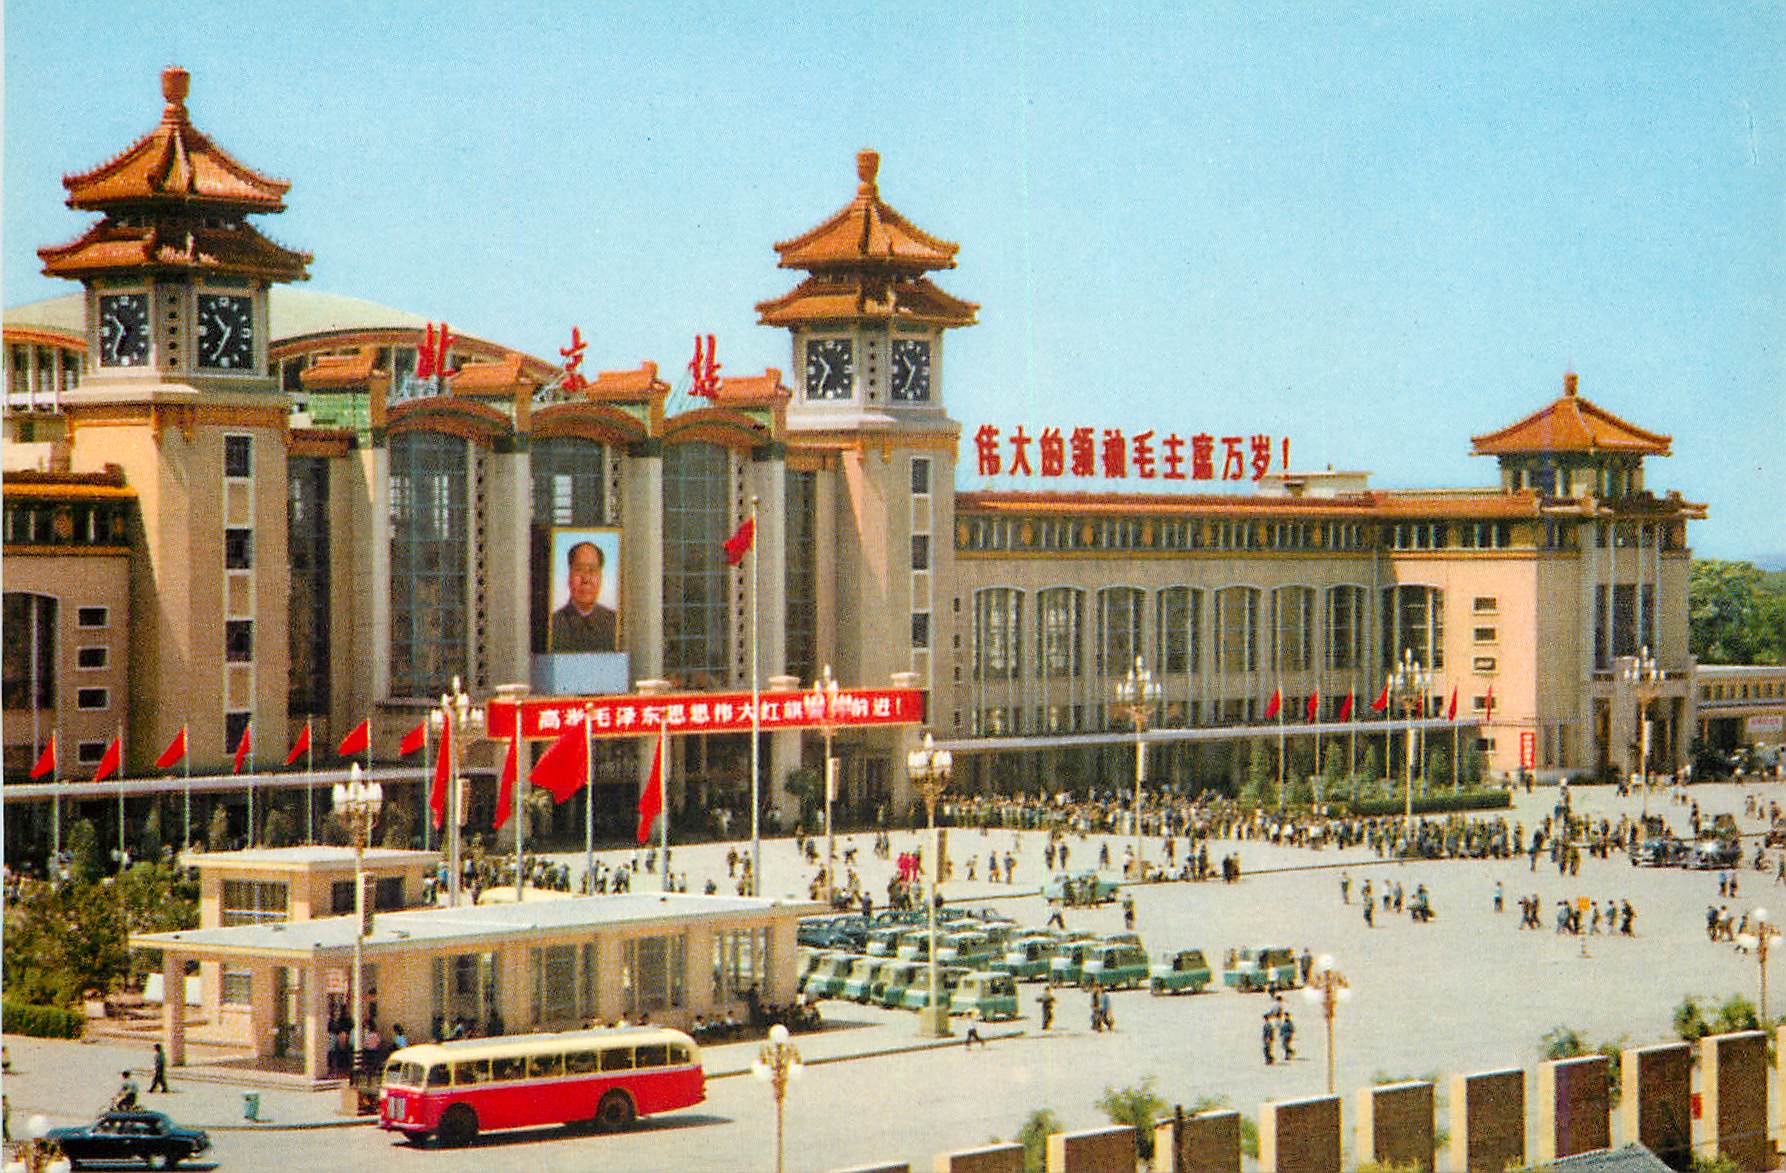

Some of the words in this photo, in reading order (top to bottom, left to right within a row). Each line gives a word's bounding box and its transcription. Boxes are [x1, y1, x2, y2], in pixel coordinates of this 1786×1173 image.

[538, 697, 901, 730] 高举毛泽东思想伟大红旗前进!
